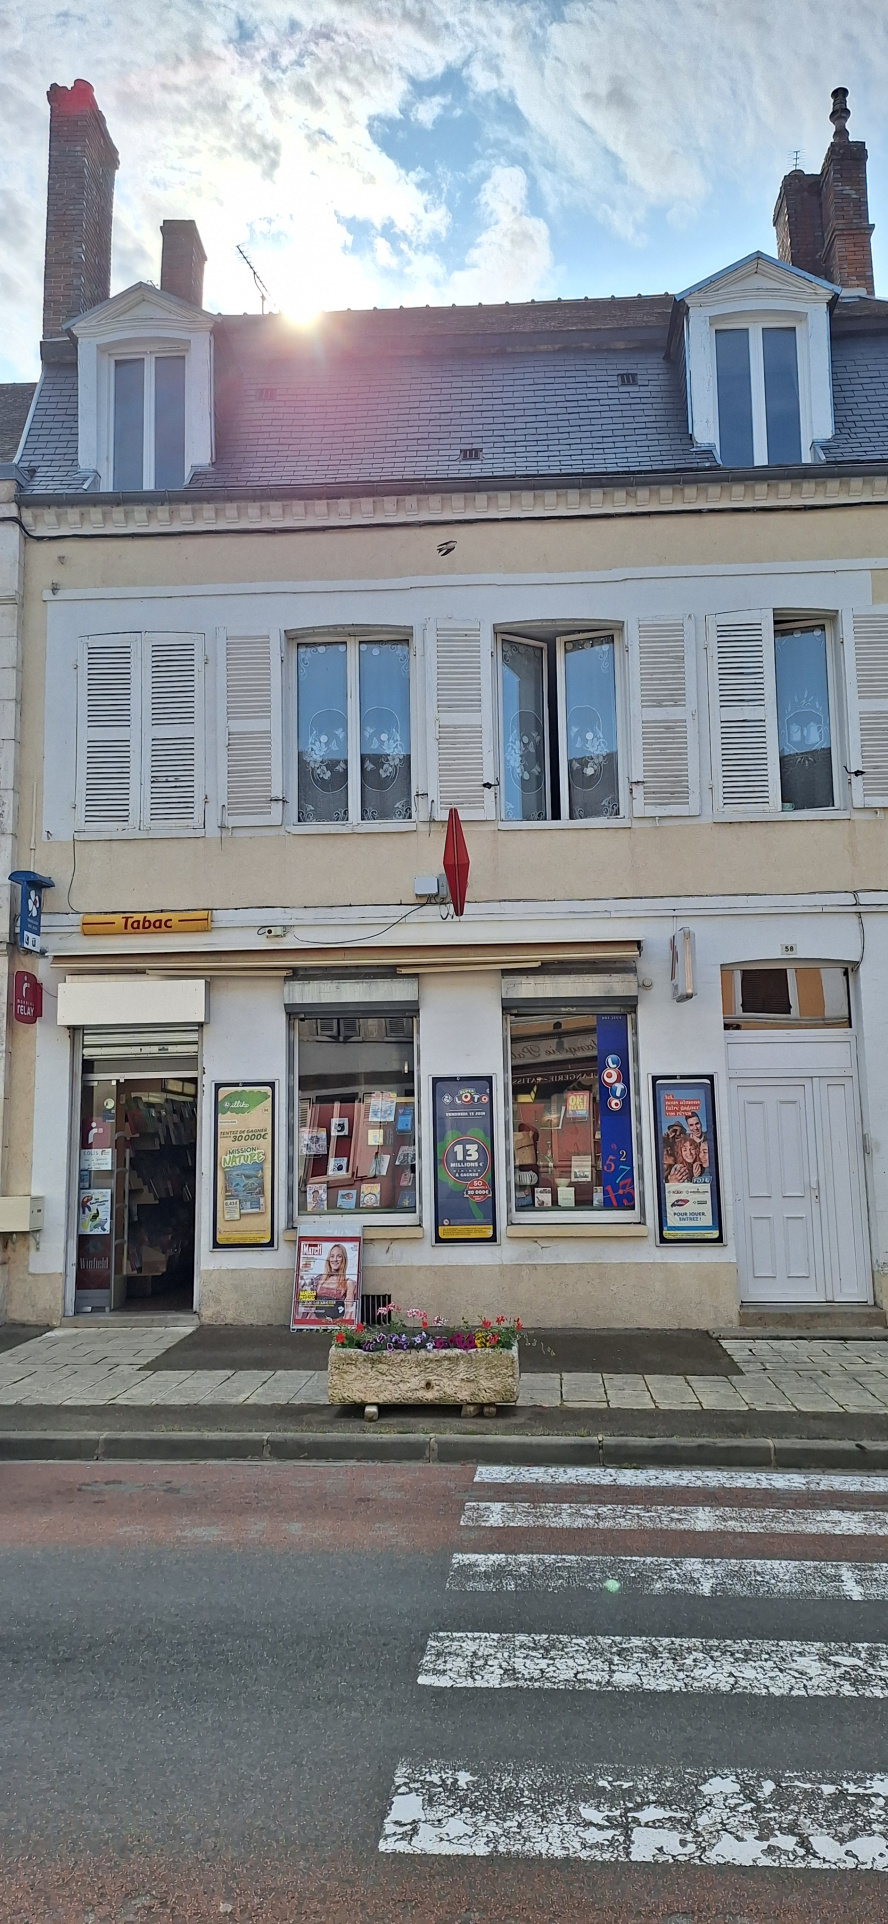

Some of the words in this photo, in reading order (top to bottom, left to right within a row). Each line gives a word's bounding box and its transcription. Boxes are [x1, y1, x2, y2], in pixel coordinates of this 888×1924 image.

[121, 915, 173, 930] Tabac
[784, 945, 795, 953] 58
[602, 1054, 628, 1111] LOTO
[454, 1092, 488, 1105] LOTO
[569, 1094, 587, 1105] OK!
[231, 1135, 243, 1143] 30
[228, 1146, 257, 1155] MISSION
[453, 1143, 479, 1161] 13
[619, 1149, 627, 1161] 2
[222, 1150, 265, 1167] NATURE
[603, 1155, 616, 1173] 5
[615, 1165, 631, 1184] 7
[80, 1256, 109, 1270] Winfield
